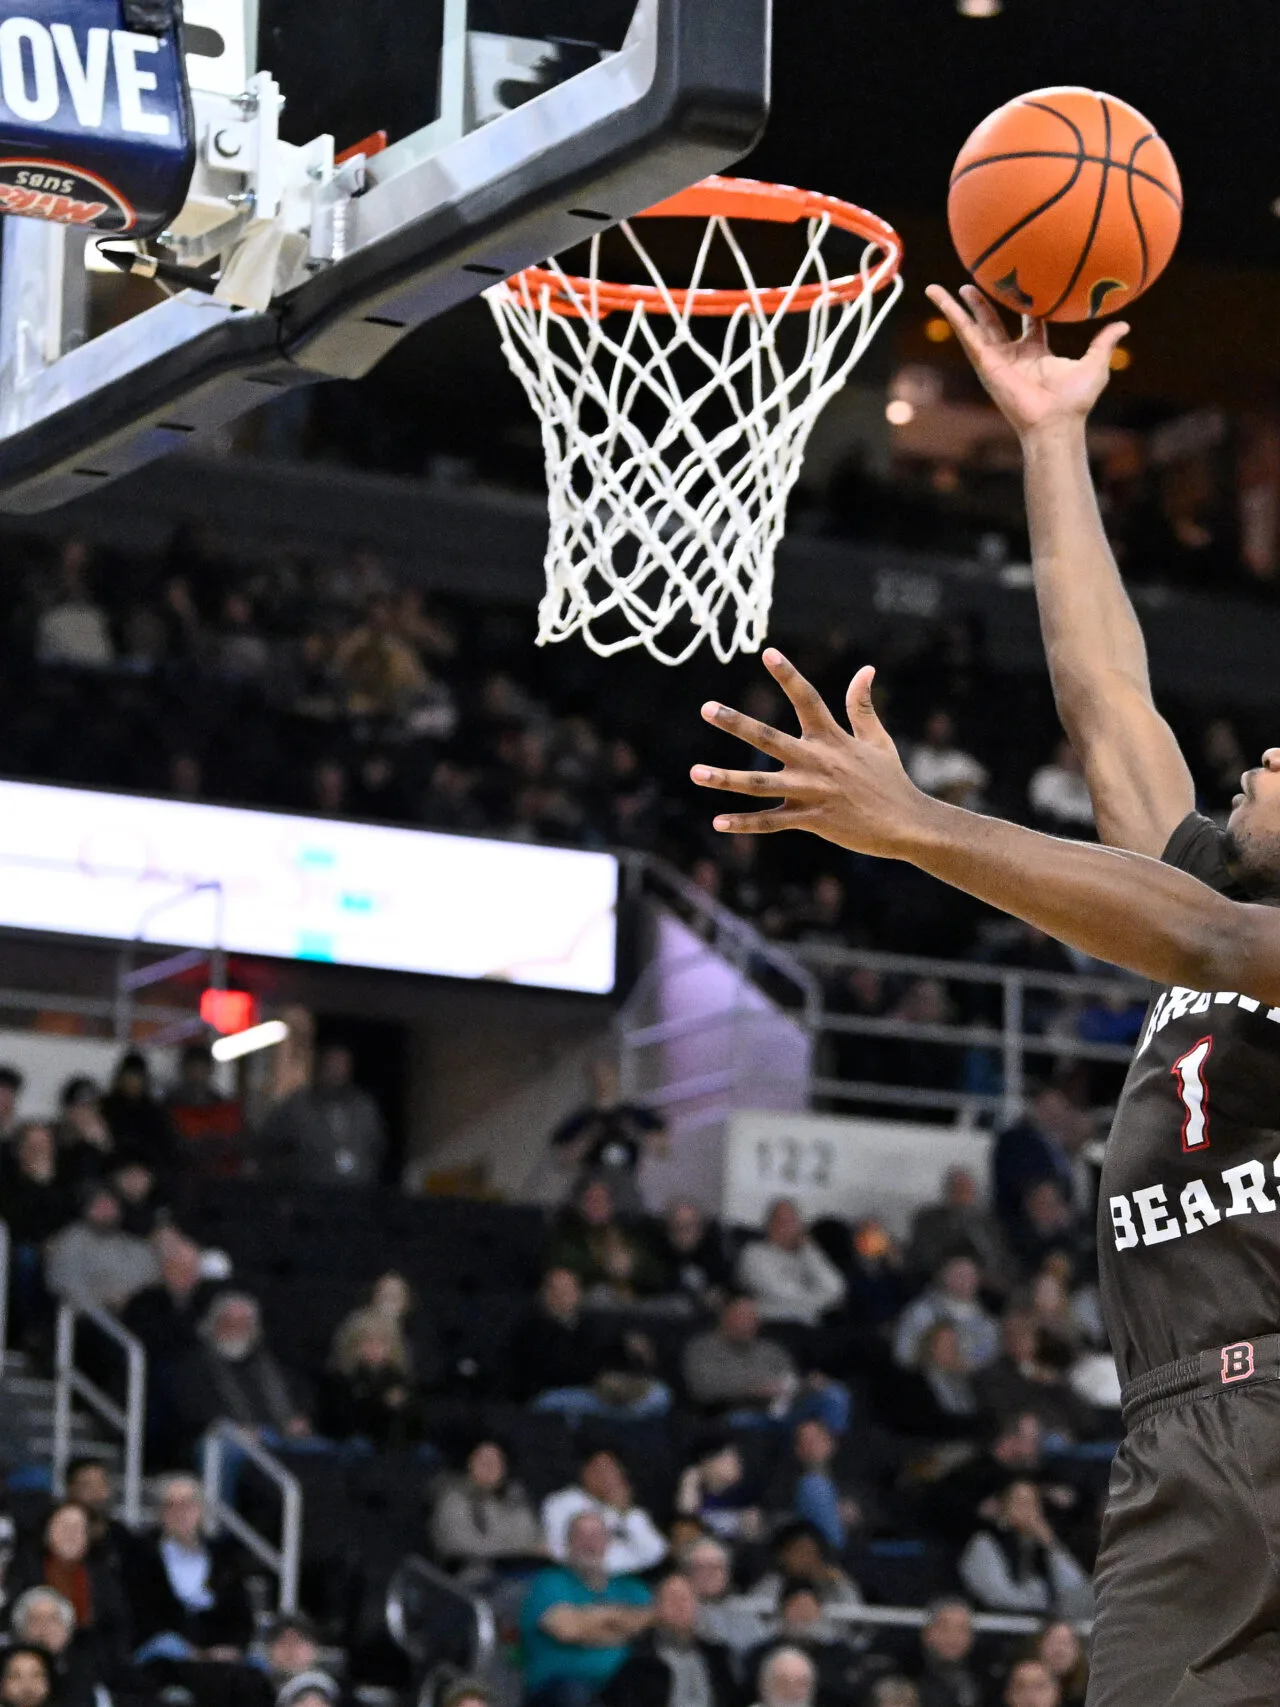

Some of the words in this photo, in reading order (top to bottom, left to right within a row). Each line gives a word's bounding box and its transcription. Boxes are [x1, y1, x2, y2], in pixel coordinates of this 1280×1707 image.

[15, 171, 75, 194] SUBS
[1171, 1035, 1213, 1152] 1
[756, 1136, 838, 1188] 122
[1221, 1341, 1254, 1384] B
